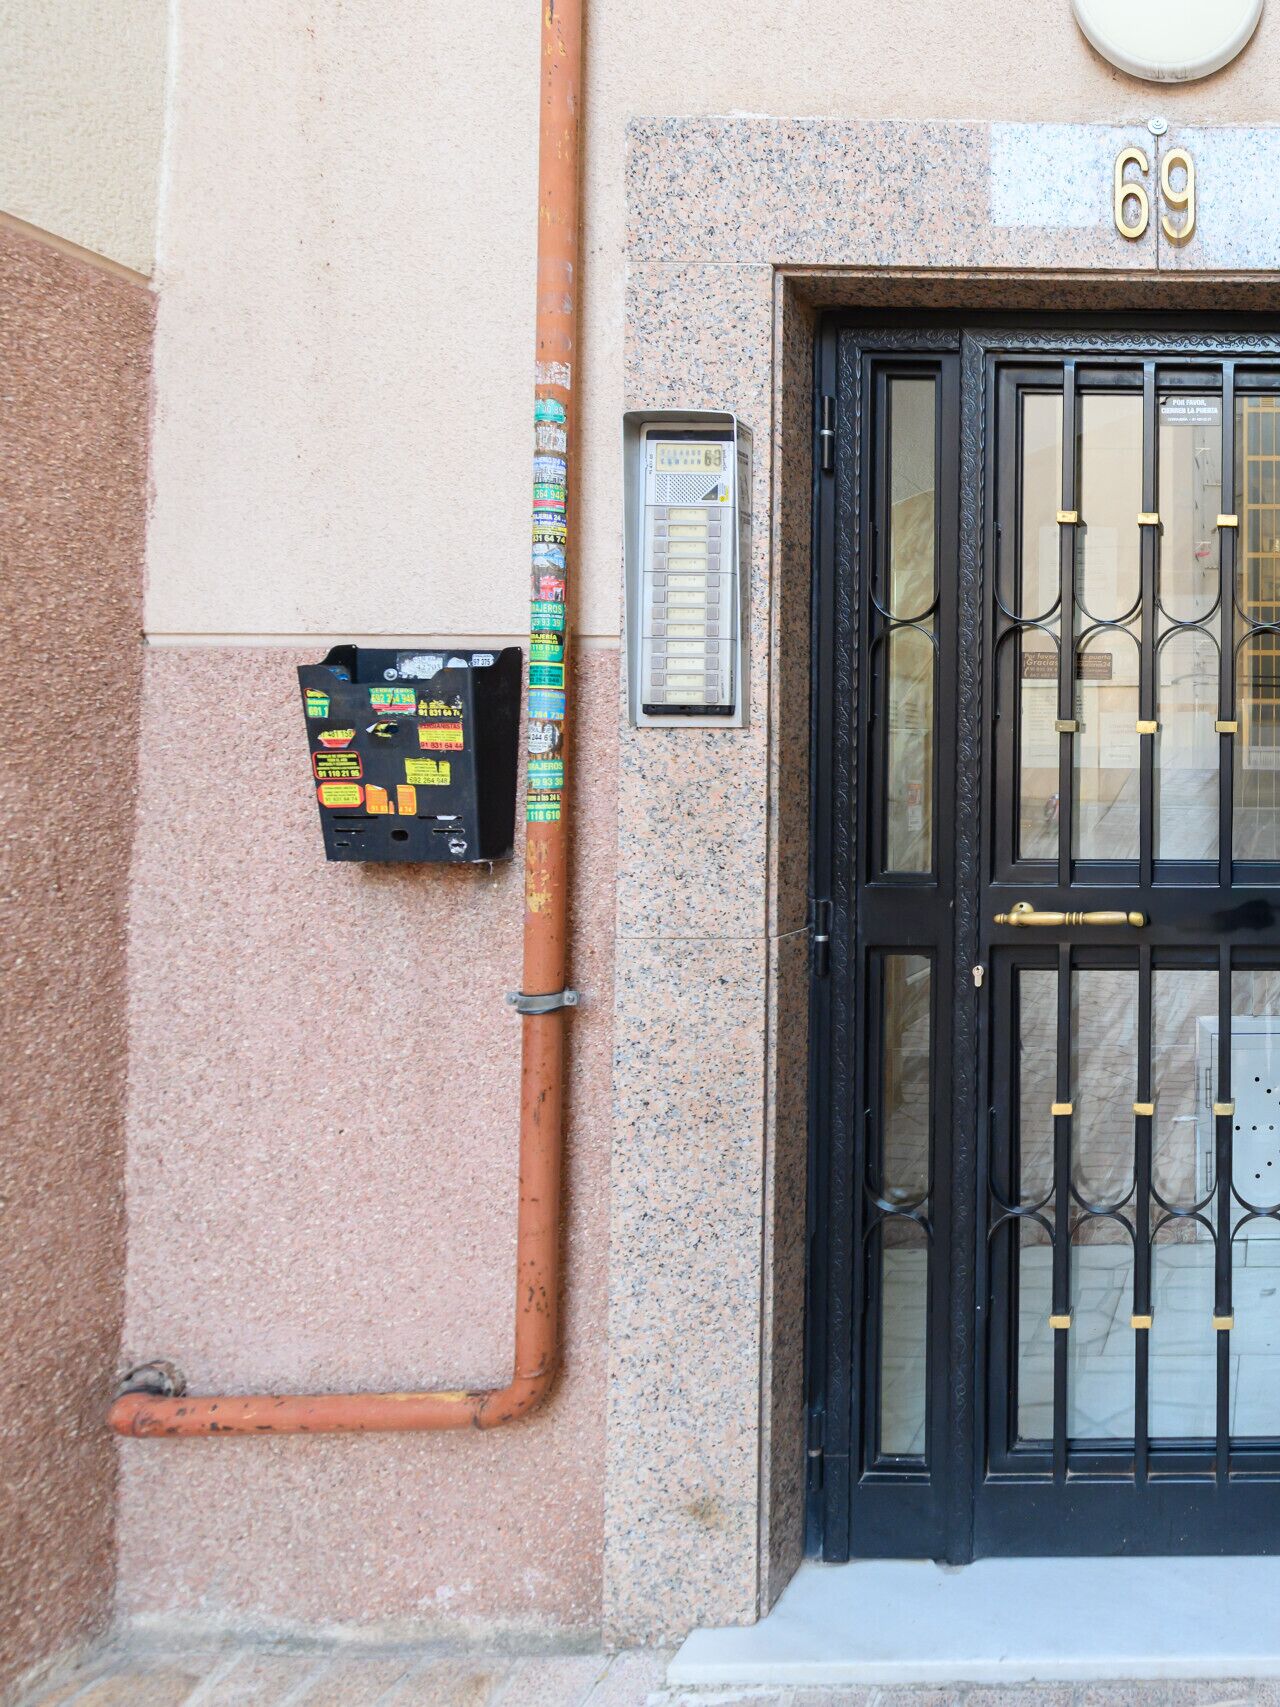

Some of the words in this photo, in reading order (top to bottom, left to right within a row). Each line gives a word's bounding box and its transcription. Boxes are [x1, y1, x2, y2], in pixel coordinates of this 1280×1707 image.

[1113, 146, 1196, 248] 69
[1186, 399, 1207, 407] FAVOR,
[341, 769, 350, 777] 21
